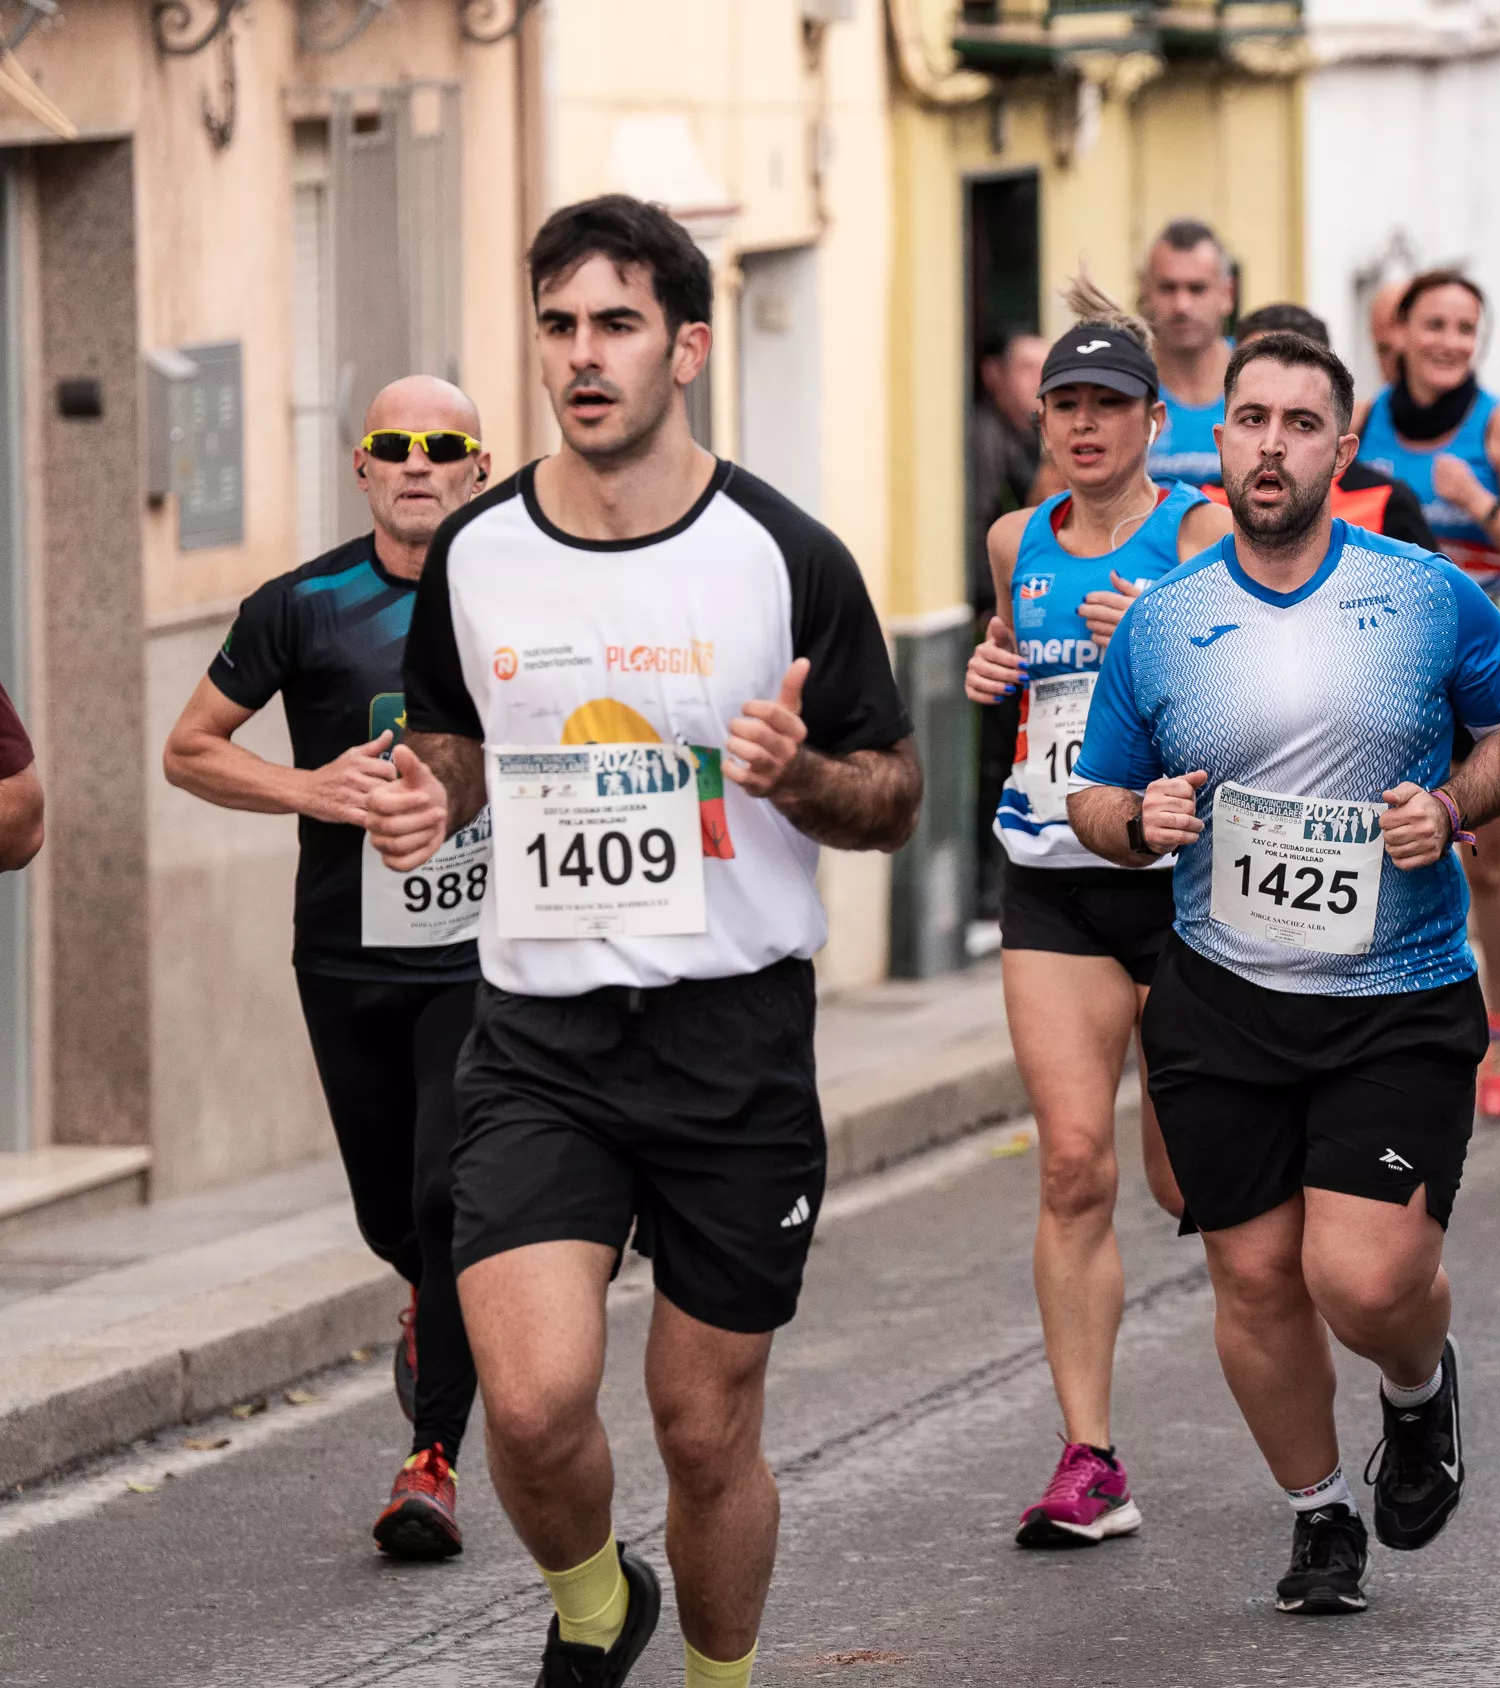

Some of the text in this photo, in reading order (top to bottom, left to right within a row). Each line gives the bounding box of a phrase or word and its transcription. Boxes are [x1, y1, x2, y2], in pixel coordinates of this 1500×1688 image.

[1339, 594, 1392, 609] CAFETERIA
[591, 748, 649, 772] 2024
[1218, 801, 1254, 817] DIPUTACIÓN
[1220, 794, 1303, 819] CARRERAS POPULARES
[1221, 787, 1304, 811] CIRCUITO PROVINCIAL DE
[1304, 804, 1350, 822] 2024
[526, 827, 676, 888] 1409
[1252, 837, 1266, 846] XXV
[1280, 843, 1304, 852] CIUDAD
[1315, 848, 1341, 856] LUCENA
[1265, 849, 1278, 857] POR
[1289, 853, 1324, 863] IGUALDAD
[403, 862, 488, 913] 988
[1234, 854, 1359, 915] 1425
[1250, 910, 1272, 921] JORGE
[1272, 917, 1305, 928] SANCHEZ
[1306, 923, 1326, 931] ALBA
